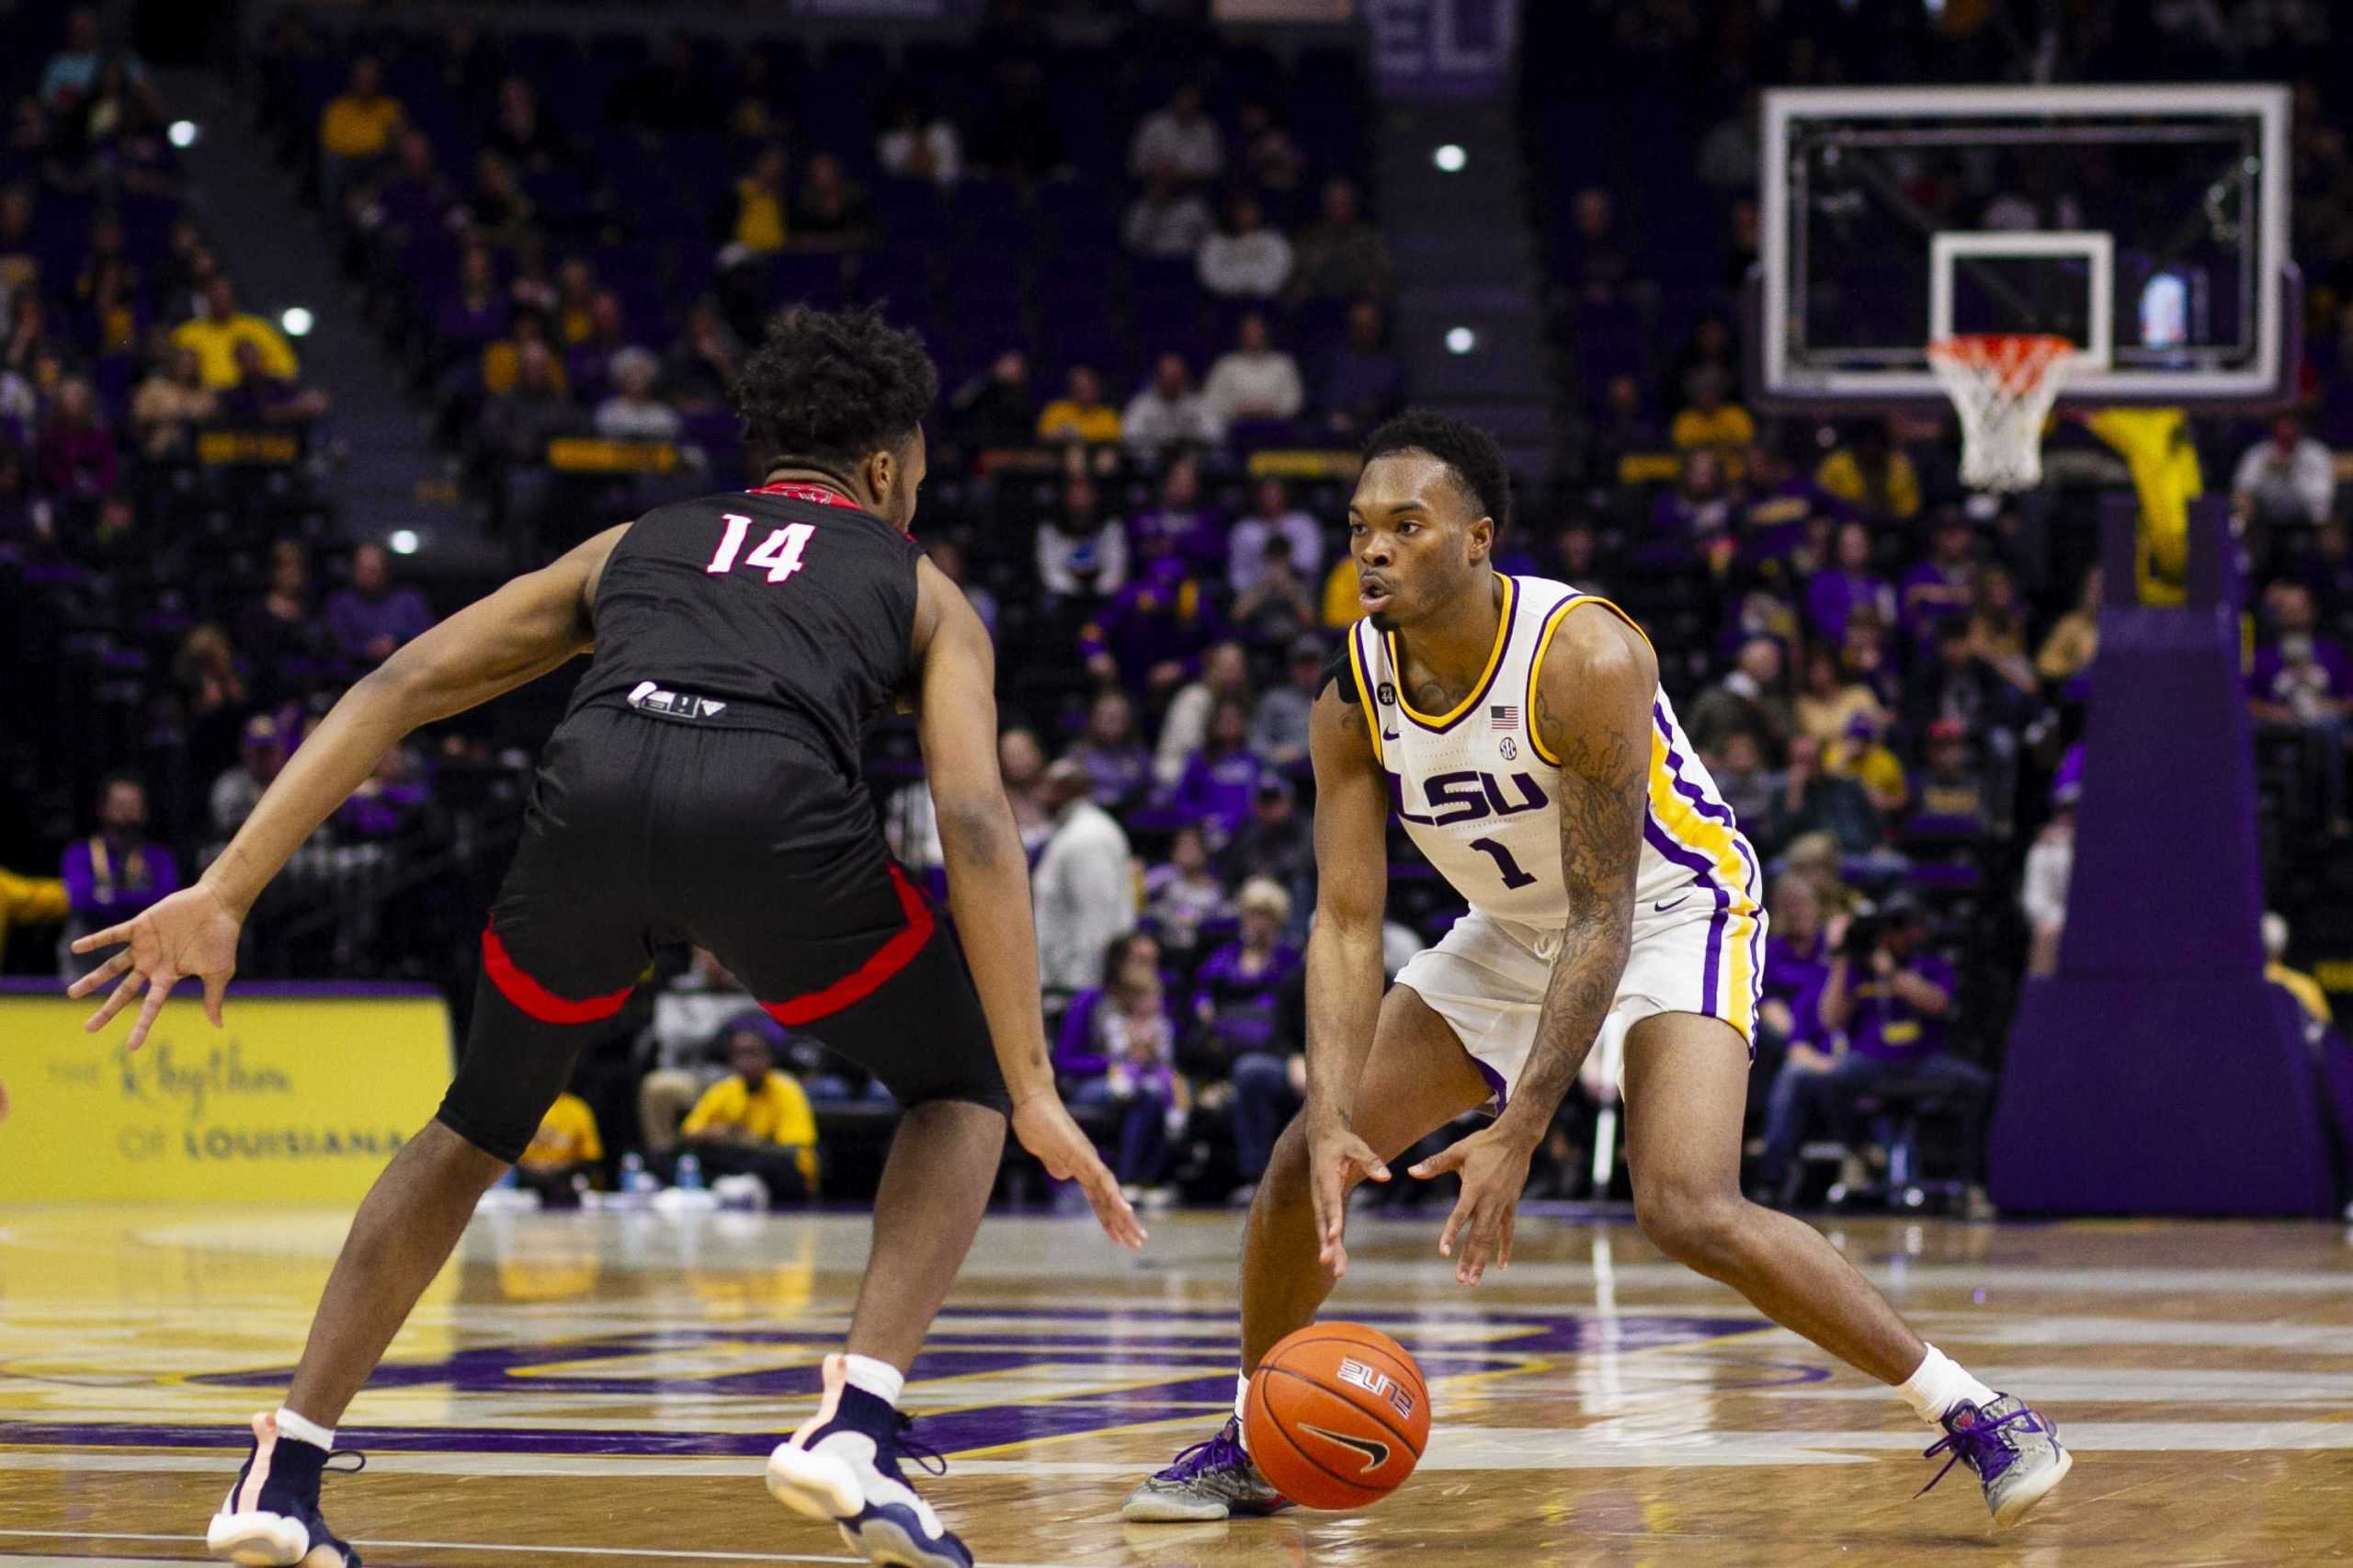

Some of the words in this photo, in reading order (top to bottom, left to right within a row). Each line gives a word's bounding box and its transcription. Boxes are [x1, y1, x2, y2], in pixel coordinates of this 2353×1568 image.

[705, 512, 818, 585] 14
[1385, 770, 1550, 827] LSU
[1468, 837, 1538, 890] 1
[1337, 1358, 1413, 1420] ELITE
